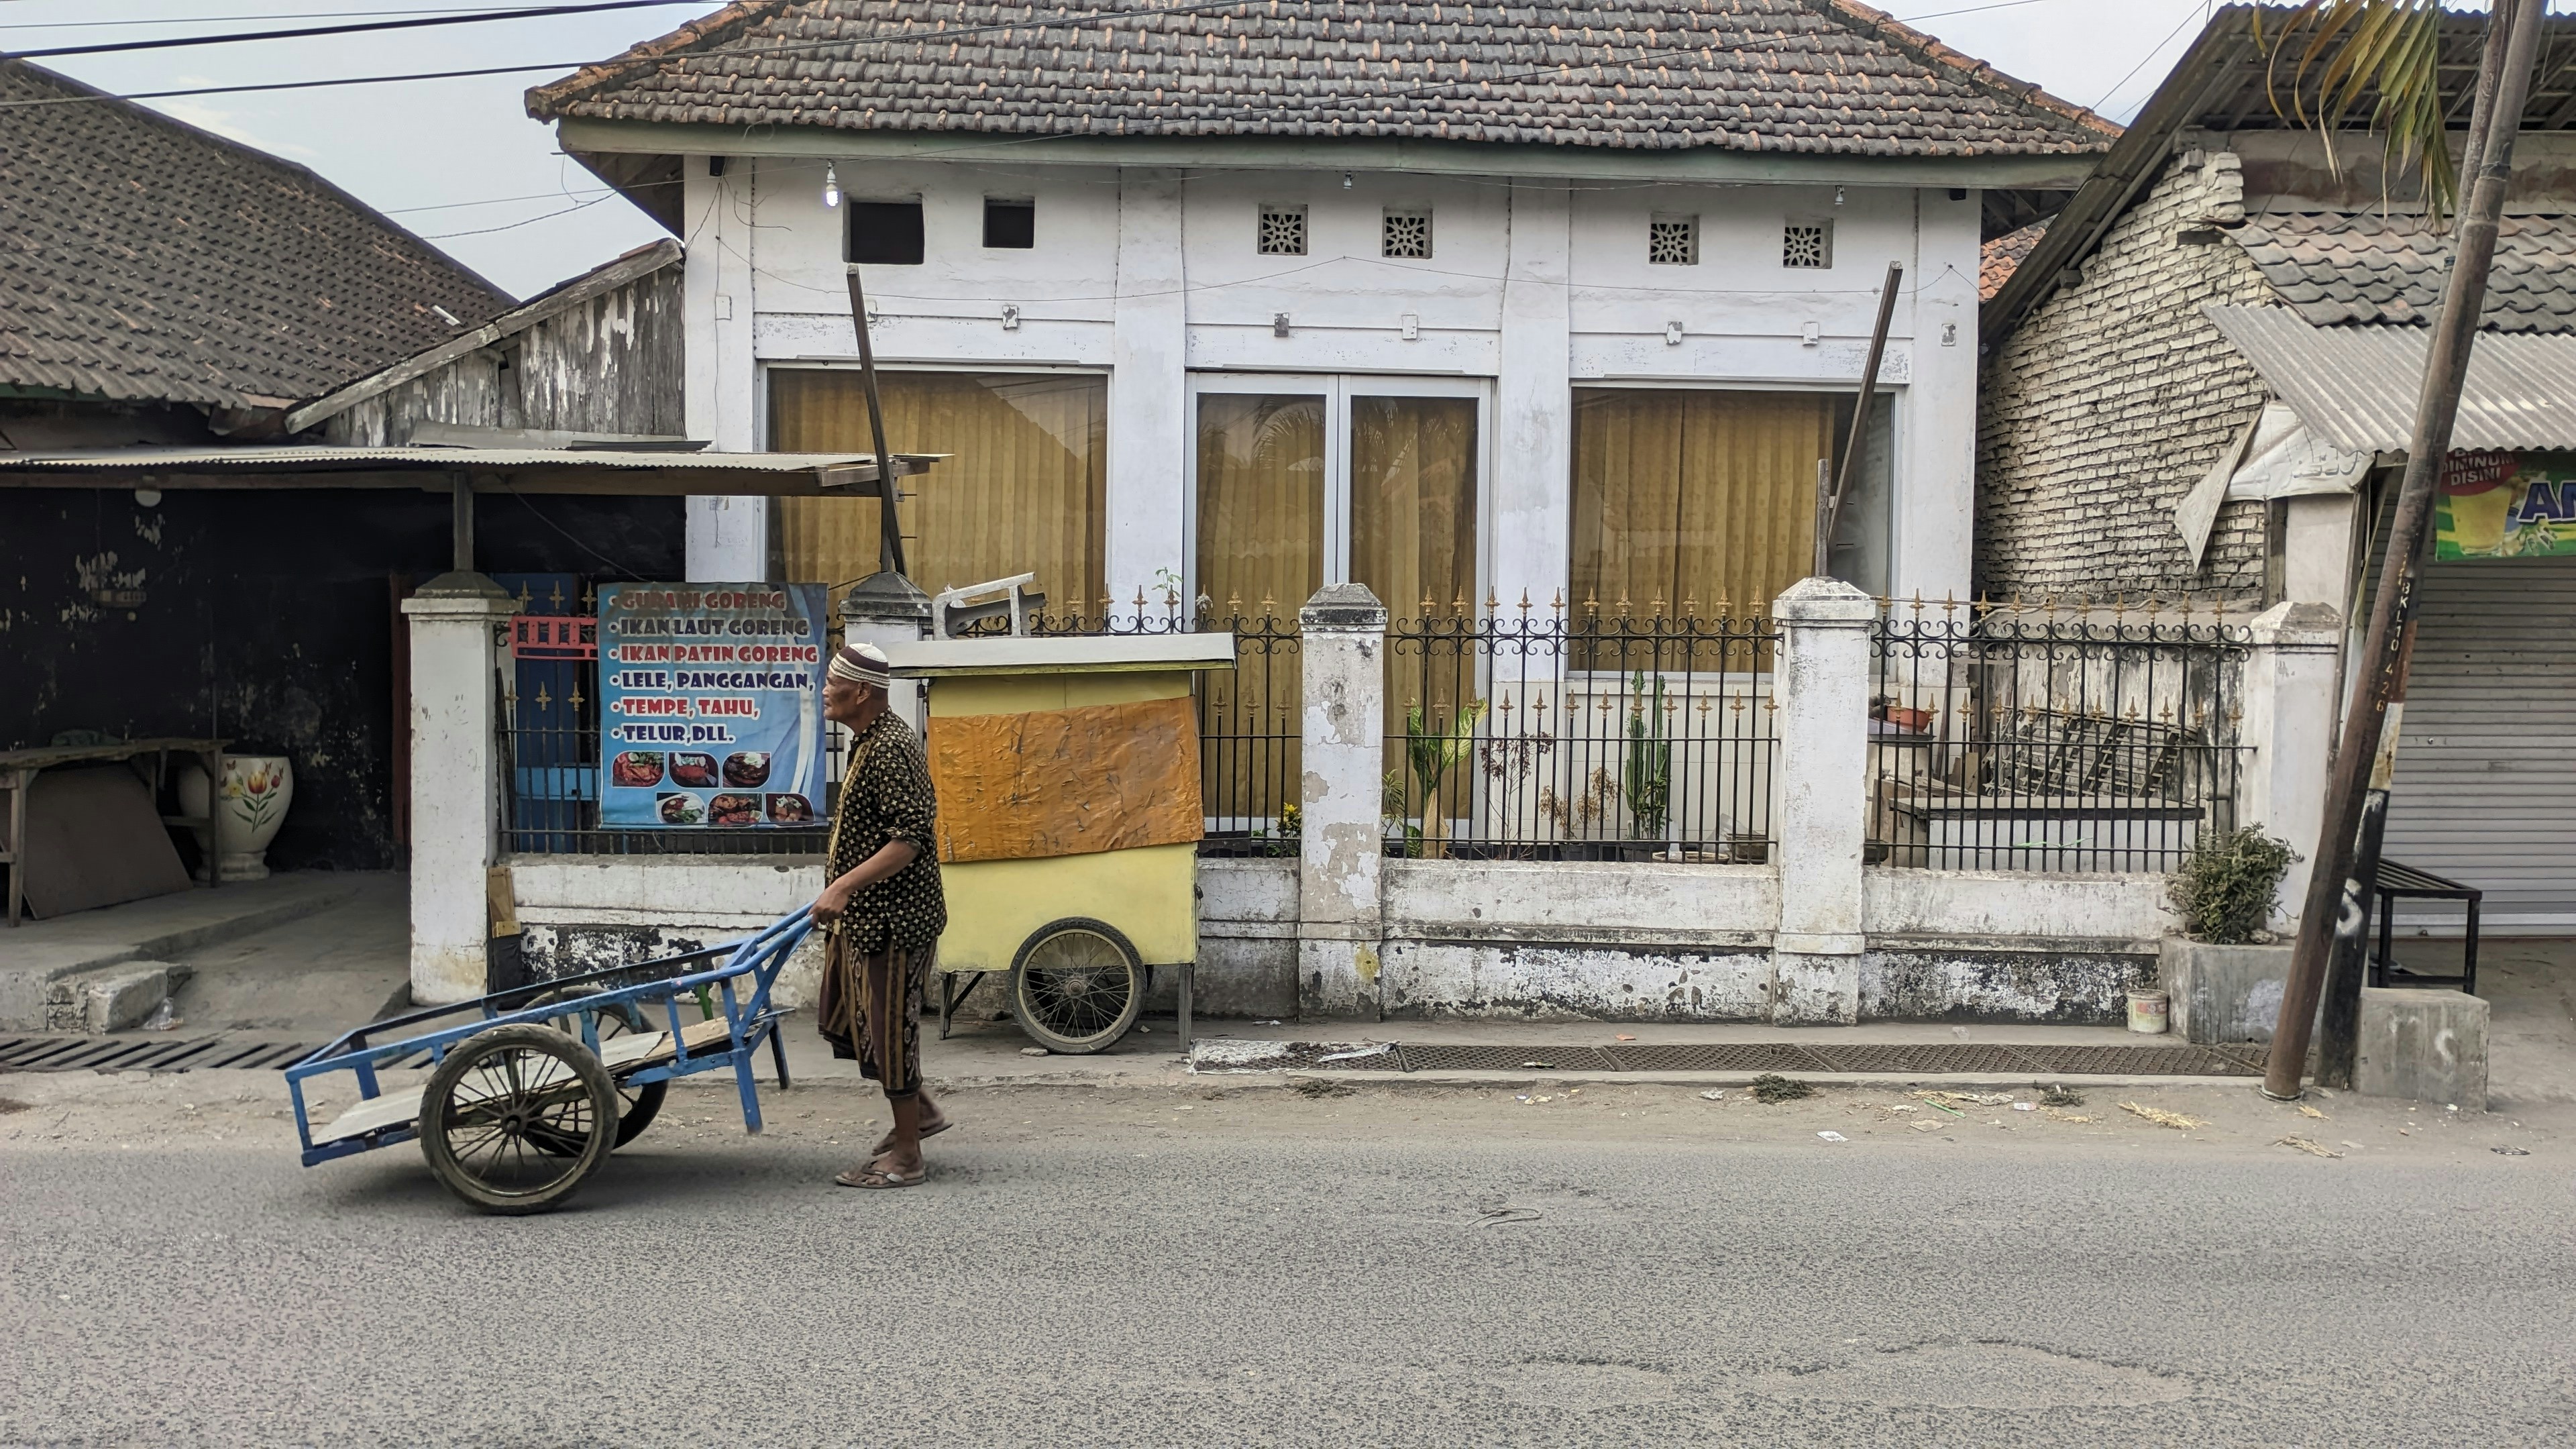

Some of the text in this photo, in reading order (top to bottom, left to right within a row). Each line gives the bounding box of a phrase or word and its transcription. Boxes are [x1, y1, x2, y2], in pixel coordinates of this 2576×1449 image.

[2451, 467, 2501, 486] DISINI
[704, 592, 786, 610] GORENG
[620, 619, 809, 637] IKAN LAUT GORENG
[621, 645, 818, 663] IKAN PATIN GORENG
[621, 672, 815, 692] LELE, PANGGANGAN,
[622, 698, 759, 718] TEMPE, TAHU,
